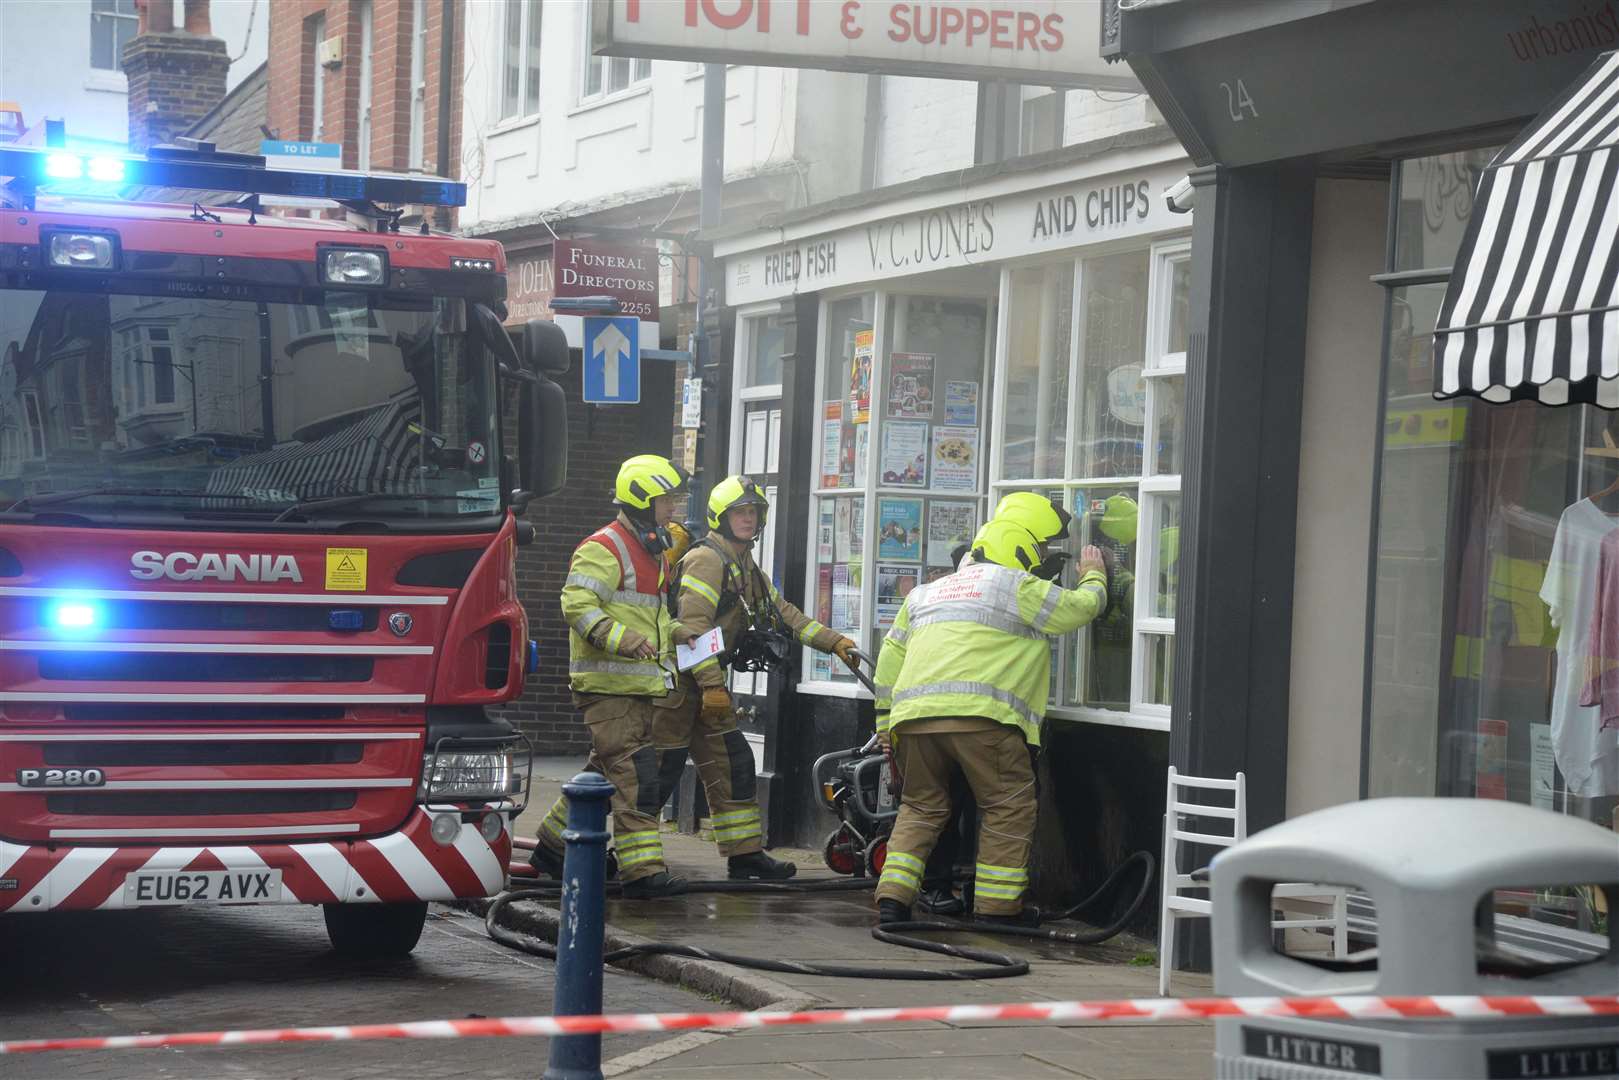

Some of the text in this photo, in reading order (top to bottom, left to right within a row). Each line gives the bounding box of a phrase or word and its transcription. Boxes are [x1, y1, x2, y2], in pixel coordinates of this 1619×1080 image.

[888, 4, 1064, 53] SUPPERS
[1220, 80, 1259, 121] 24
[284, 144, 317, 154] TO LET
[1032, 180, 1149, 238] AND CHIPS
[865, 200, 994, 272] V. C. JONES
[570, 248, 646, 271] FUNERAL
[764, 250, 801, 286] FRIED
[807, 241, 836, 277] FISH
[516, 260, 555, 298] JOHN
[561, 268, 655, 292] DIRECTORS
[618, 301, 651, 314] 2255
[130, 551, 303, 582] SCANIA
[22, 769, 102, 785] P 280
[137, 873, 271, 901] EU62 AVX
[1266, 1034, 1357, 1069] LITTER
